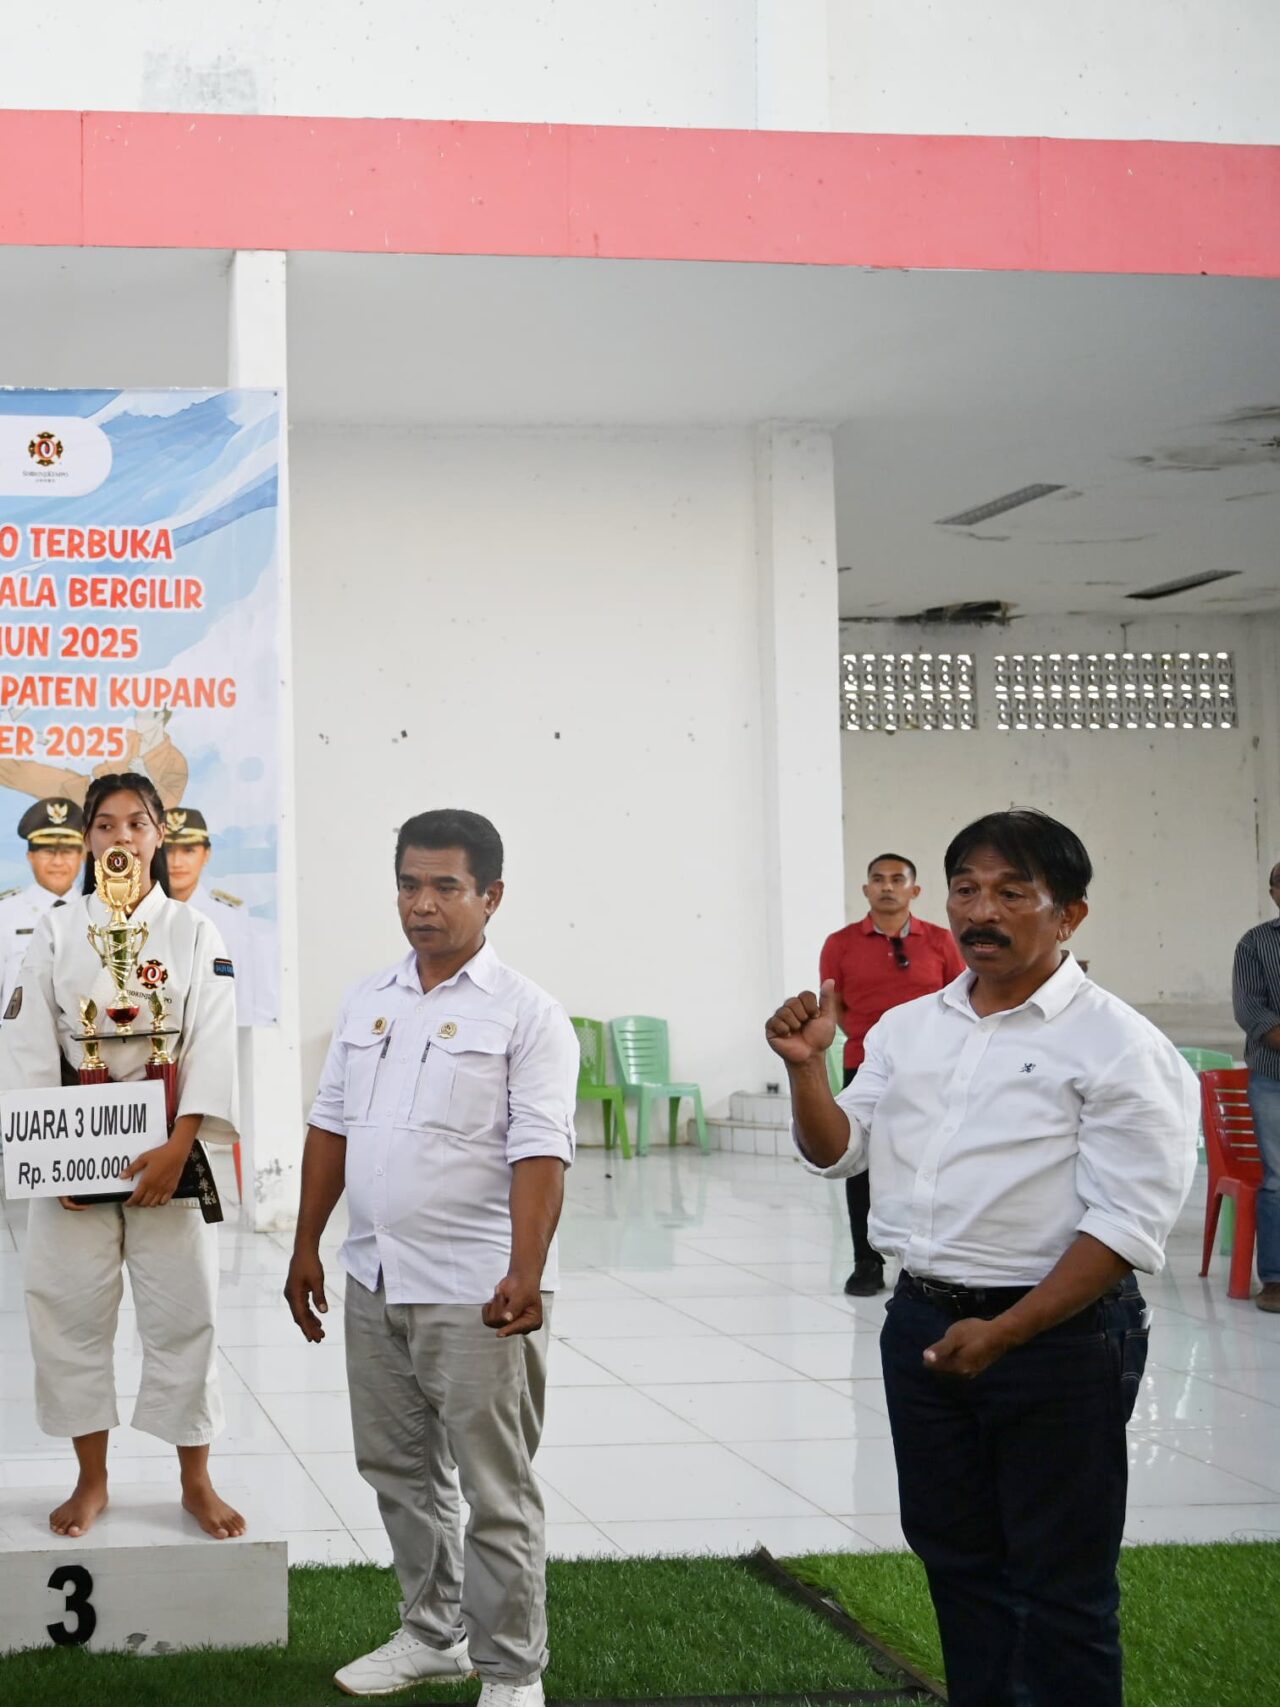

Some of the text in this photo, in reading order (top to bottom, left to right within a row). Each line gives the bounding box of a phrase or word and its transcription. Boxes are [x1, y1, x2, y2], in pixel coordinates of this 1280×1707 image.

[30, 527, 173, 560] TERBUKA
[69, 577, 203, 610] BERGILIR
[61, 627, 139, 659] 2025
[110, 677, 237, 709] KUPANG
[47, 726, 124, 757] 2025
[4, 1102, 148, 1143] JUARA 3 UMUM
[18, 1161, 46, 1190] Rp.
[46, 1564, 97, 1646] 3
